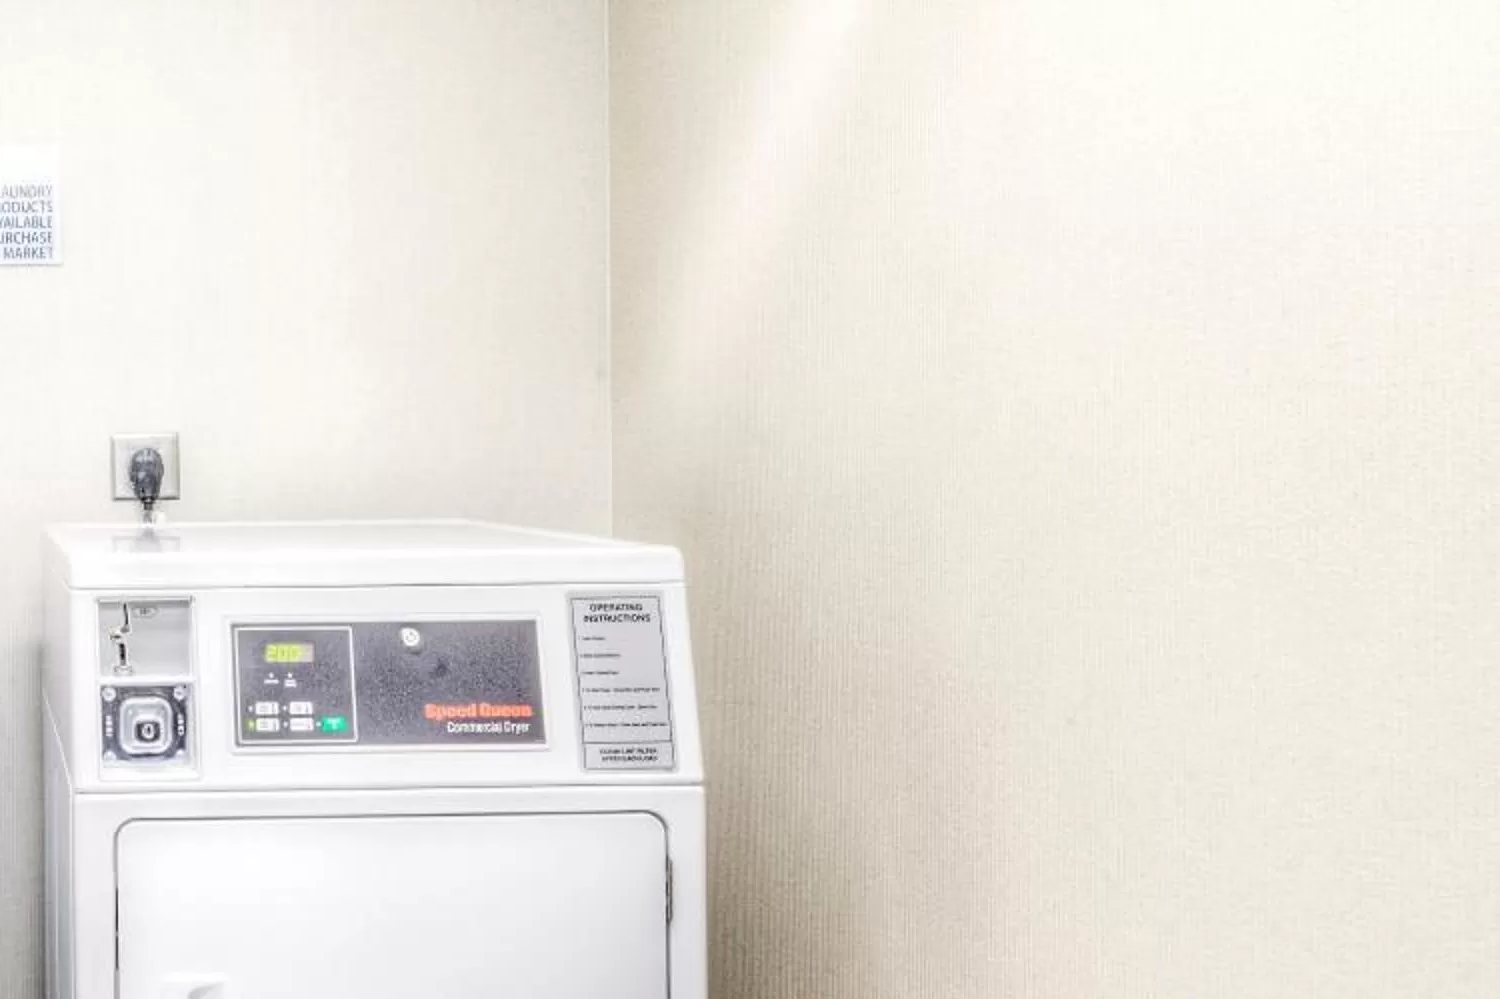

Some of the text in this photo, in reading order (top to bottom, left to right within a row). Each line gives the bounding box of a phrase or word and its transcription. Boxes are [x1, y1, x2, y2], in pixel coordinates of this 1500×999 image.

[3, 247, 53, 260] MARKET
[589, 603, 643, 612] OPERATING
[583, 613, 651, 623] INSTRUCTIONS
[425, 702, 533, 720] Speed Queen
[447, 721, 531, 734] Commercial Dryer
